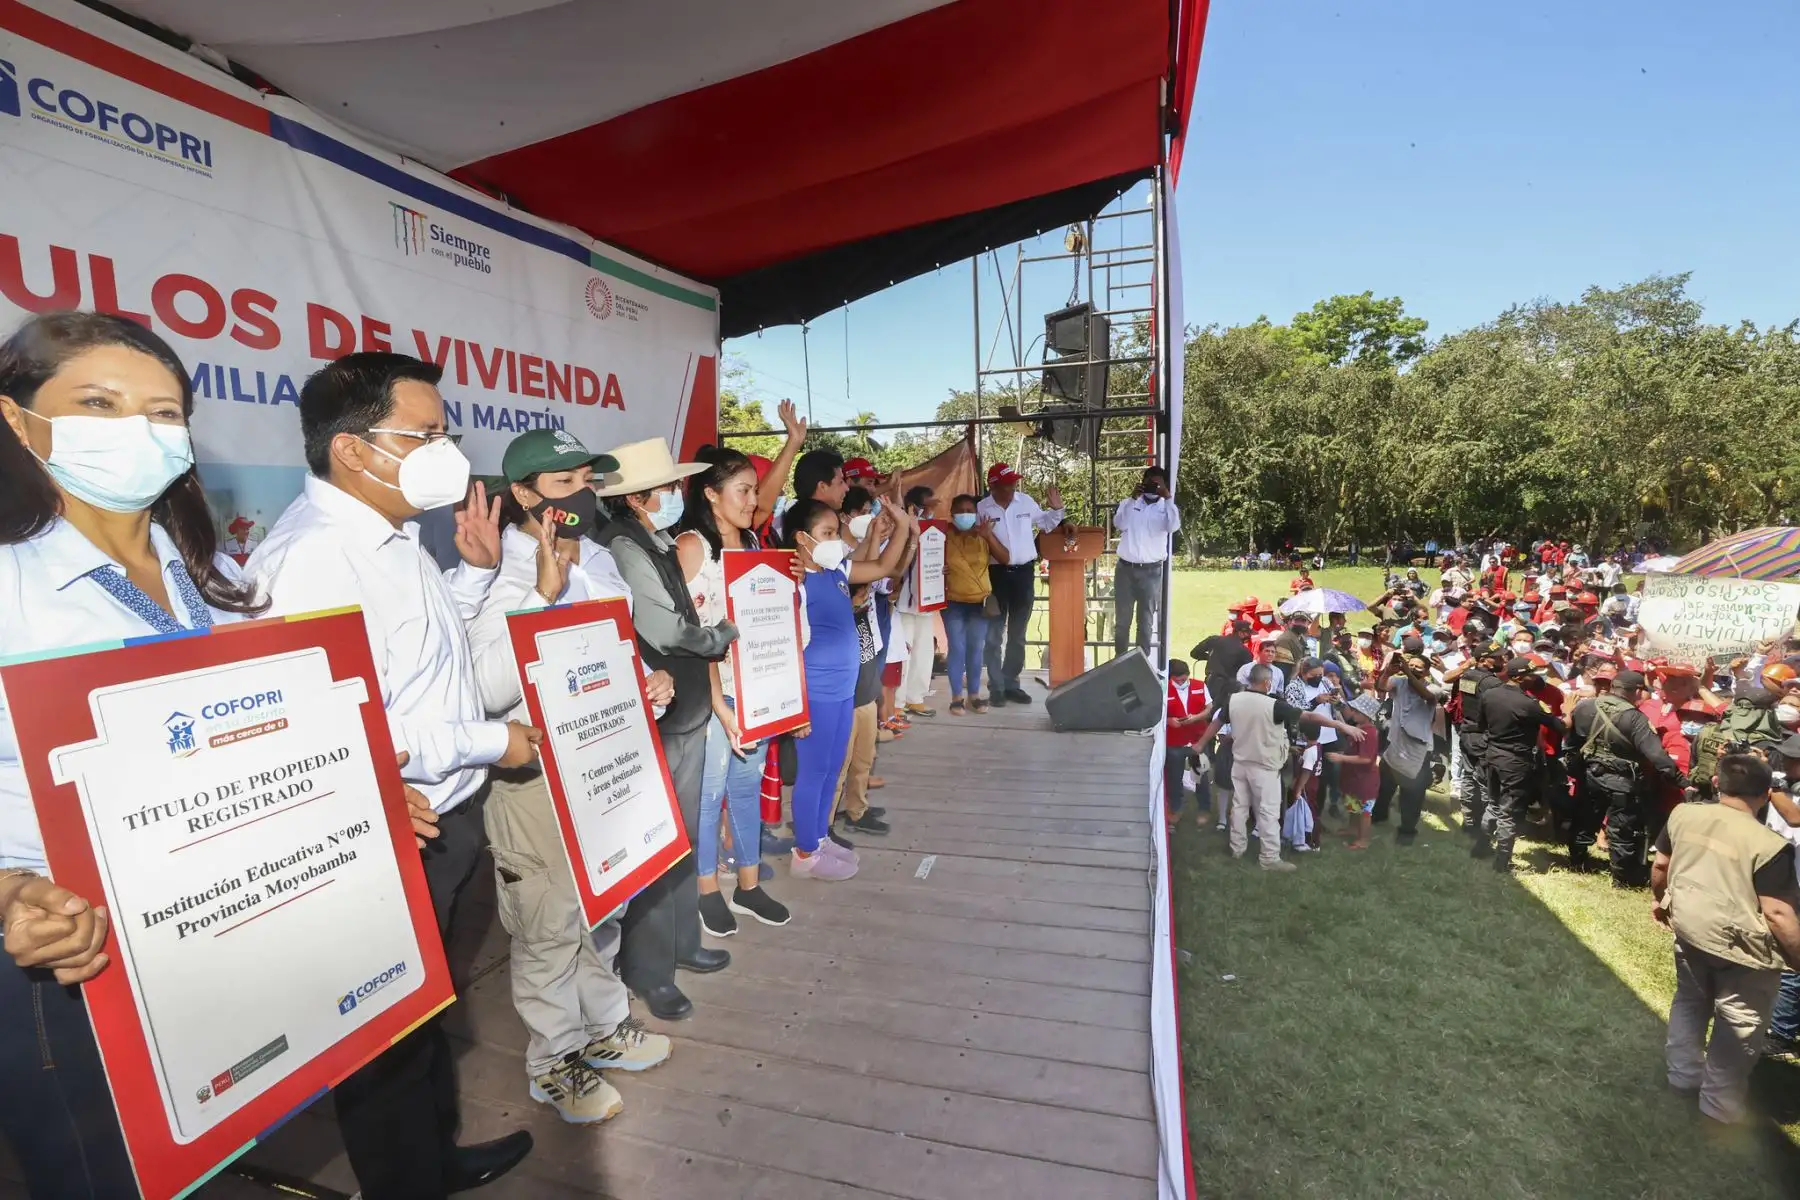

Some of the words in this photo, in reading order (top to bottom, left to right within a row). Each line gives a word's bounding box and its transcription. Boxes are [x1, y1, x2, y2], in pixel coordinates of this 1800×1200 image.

[28, 77, 212, 168] COFOPRI
[430, 224, 490, 259] Siempre
[431, 247, 445, 257] con
[454, 253, 492, 274] pueblo
[411, 328, 626, 412] VIVIENDA
[472, 404, 565, 433] MARTÍN
[578, 660, 607, 676] COFOPRI
[201, 689, 283, 720] COFOPRI
[556, 717, 589, 736] TÍTULOS
[589, 712, 600, 724] DE
[600, 698, 637, 720] PROPIEDAD
[213, 733, 237, 747] más
[236, 725, 263, 740] cerca
[263, 721, 276, 733] de
[577, 716, 626, 741] REGISTRADOS
[581, 772, 587, 783] 7
[588, 761, 614, 780] Centros
[614, 750, 640, 768] Médicos
[587, 791, 592, 801] y
[593, 780, 611, 795] áreas
[611, 764, 643, 785] destinadas
[122, 791, 210, 832] TÍTULO
[215, 780, 244, 801] DE
[248, 746, 350, 790] PROPIEDAD
[186, 778, 314, 833] REGISTRADO
[612, 784, 631, 801] Salud
[141, 876, 243, 929] Institución
[246, 842, 325, 883] Educativa
[326, 820, 371, 849] N°093
[176, 893, 262, 940] Provincia
[265, 849, 358, 900] Moyobamba
[356, 960, 406, 998] COFOPRI
